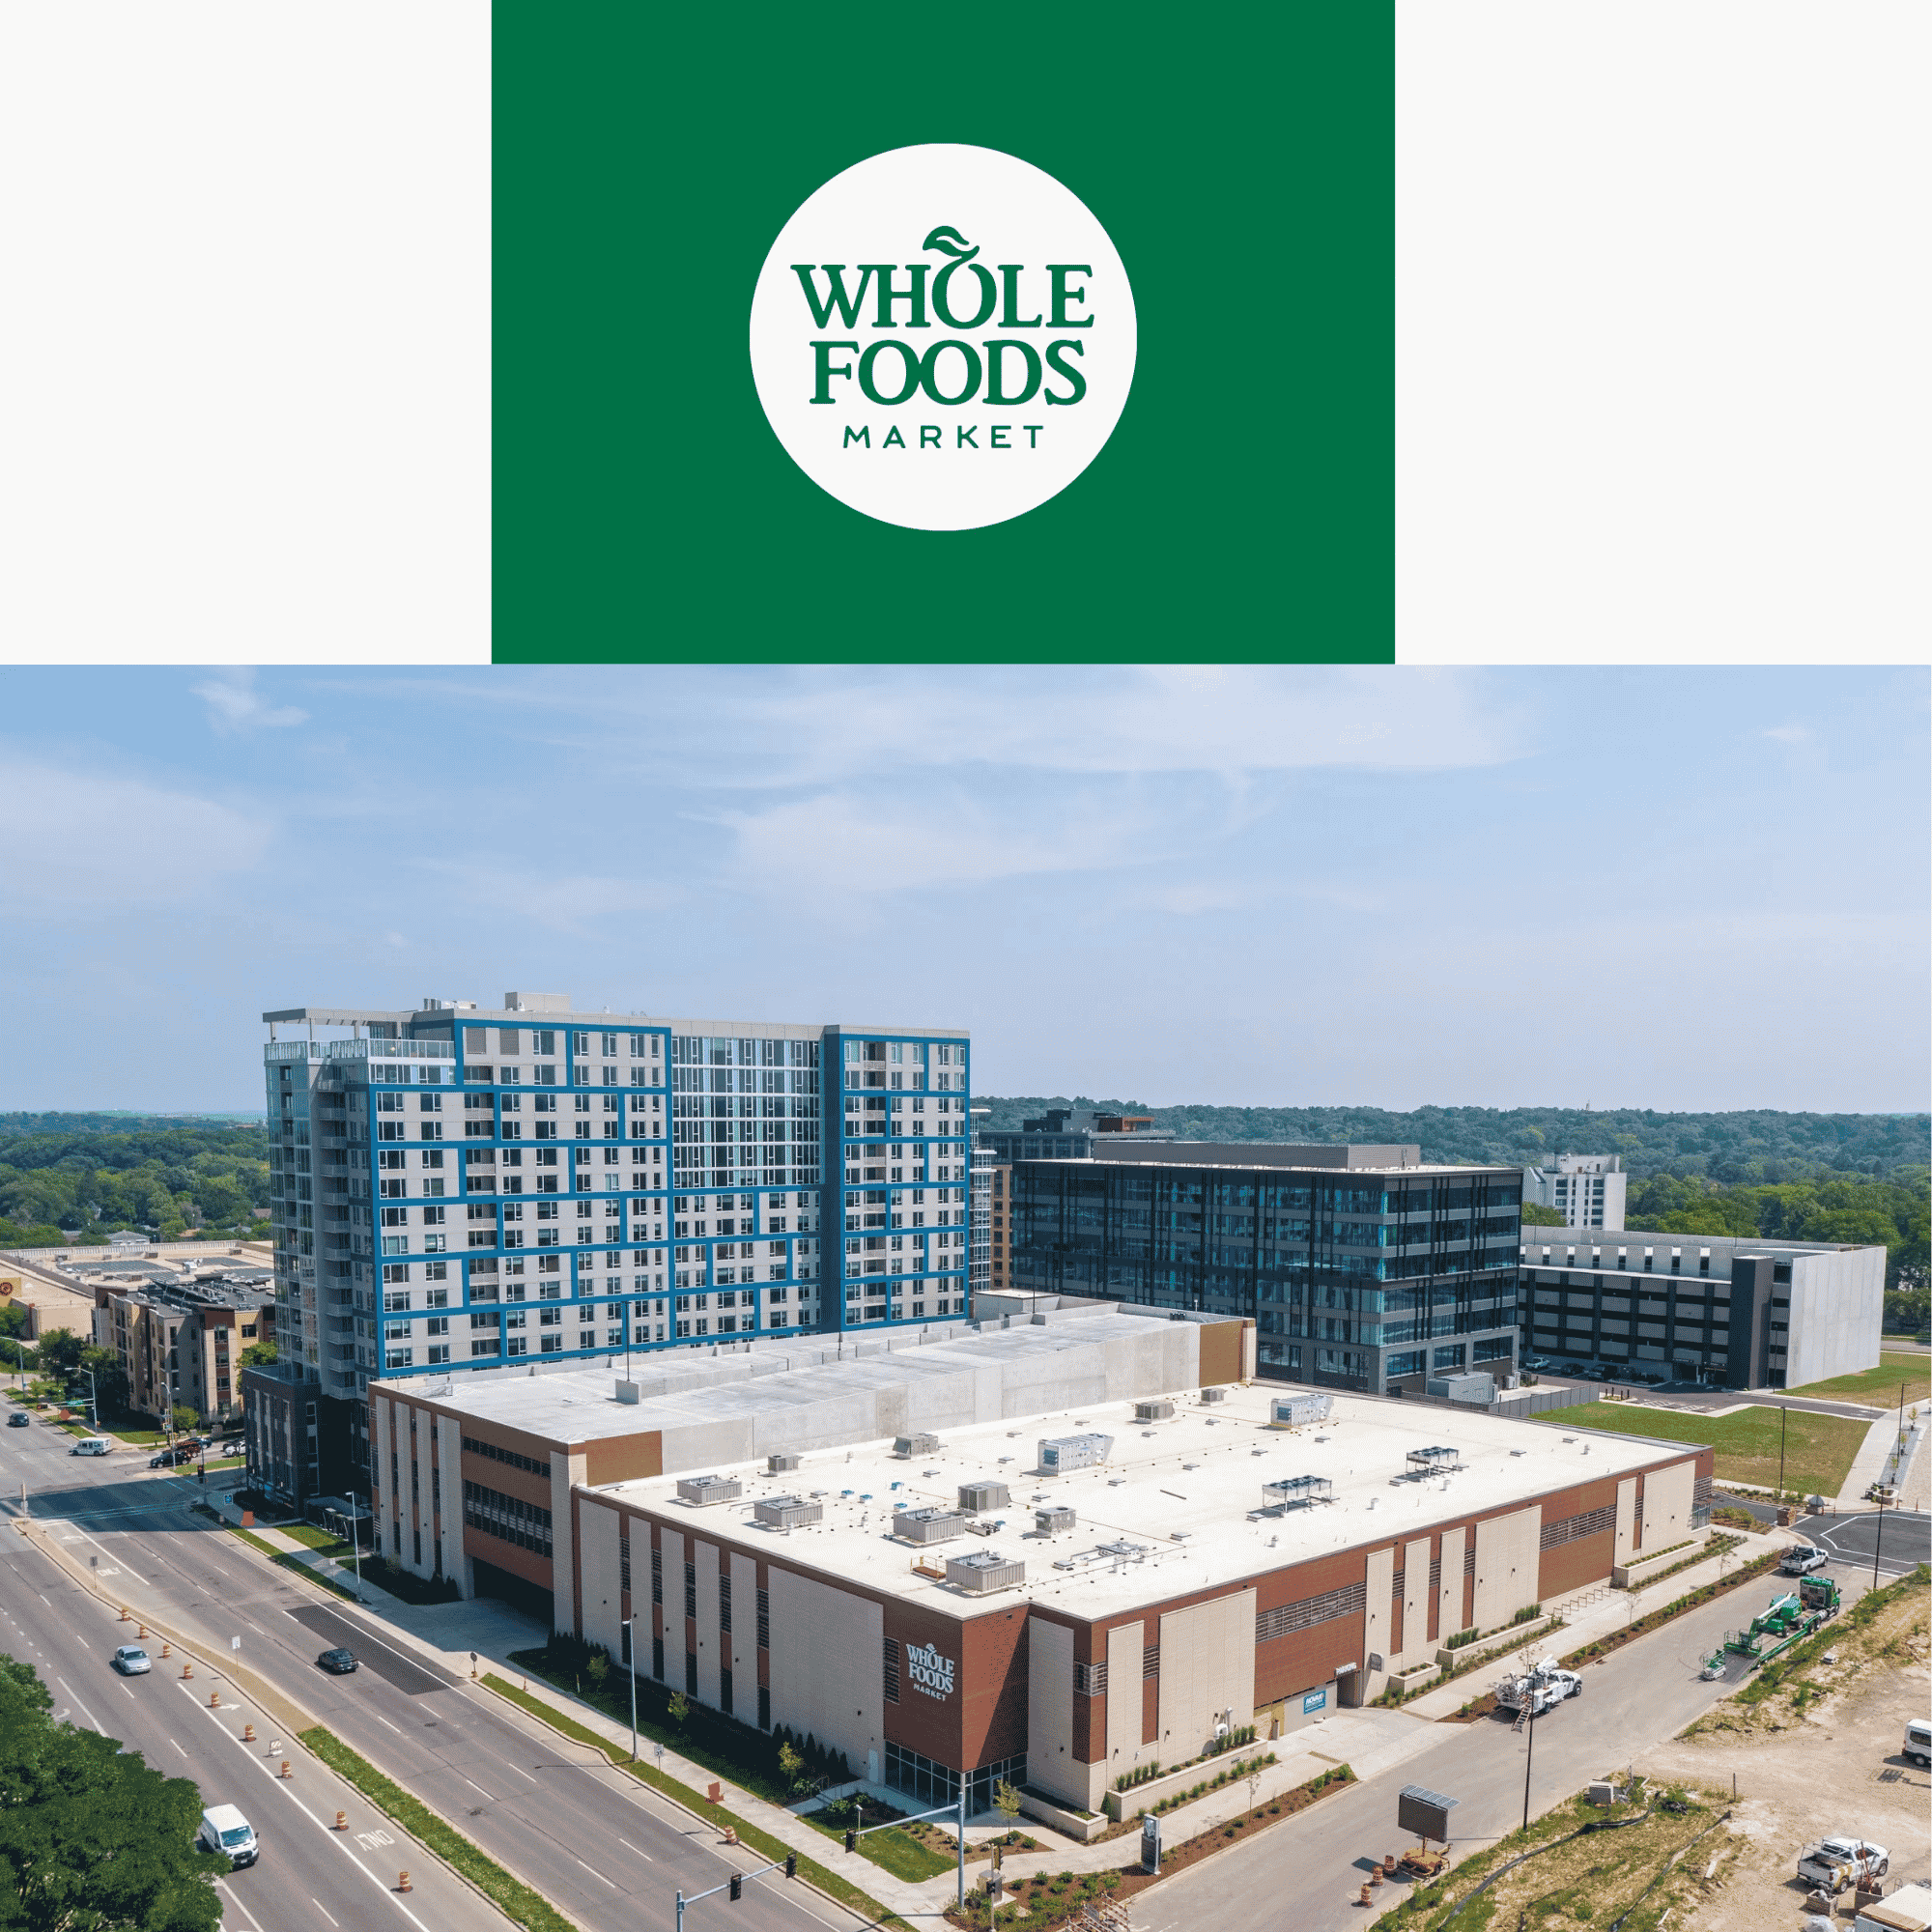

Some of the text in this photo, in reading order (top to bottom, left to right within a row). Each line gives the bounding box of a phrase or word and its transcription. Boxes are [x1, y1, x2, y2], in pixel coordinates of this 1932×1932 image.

[906, 1643, 954, 1677] WHOLE
[908, 1662, 953, 1693] FOODS
[913, 1683, 947, 1701] MARKET
[354, 1829, 395, 1852] ONLY
